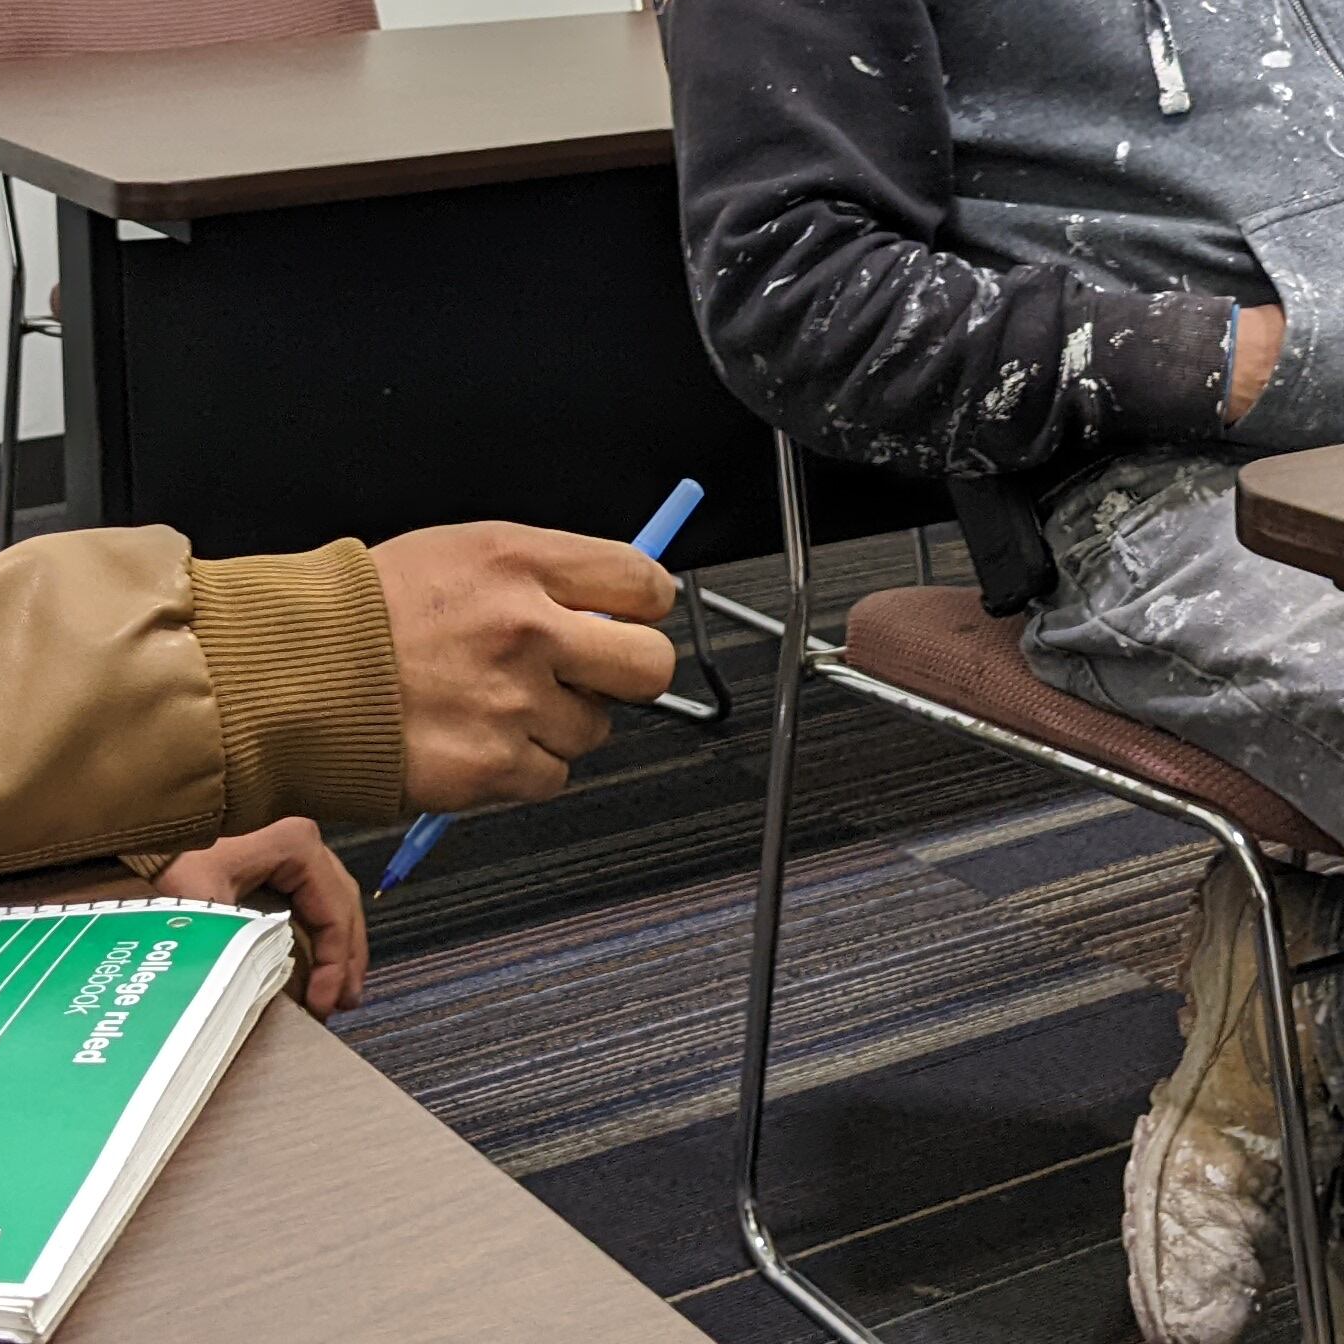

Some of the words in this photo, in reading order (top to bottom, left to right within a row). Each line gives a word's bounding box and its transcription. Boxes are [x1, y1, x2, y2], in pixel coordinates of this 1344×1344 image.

[63, 940, 140, 1015] notebook
[113, 940, 179, 1006] college
[72, 1011, 130, 1063] ruled
